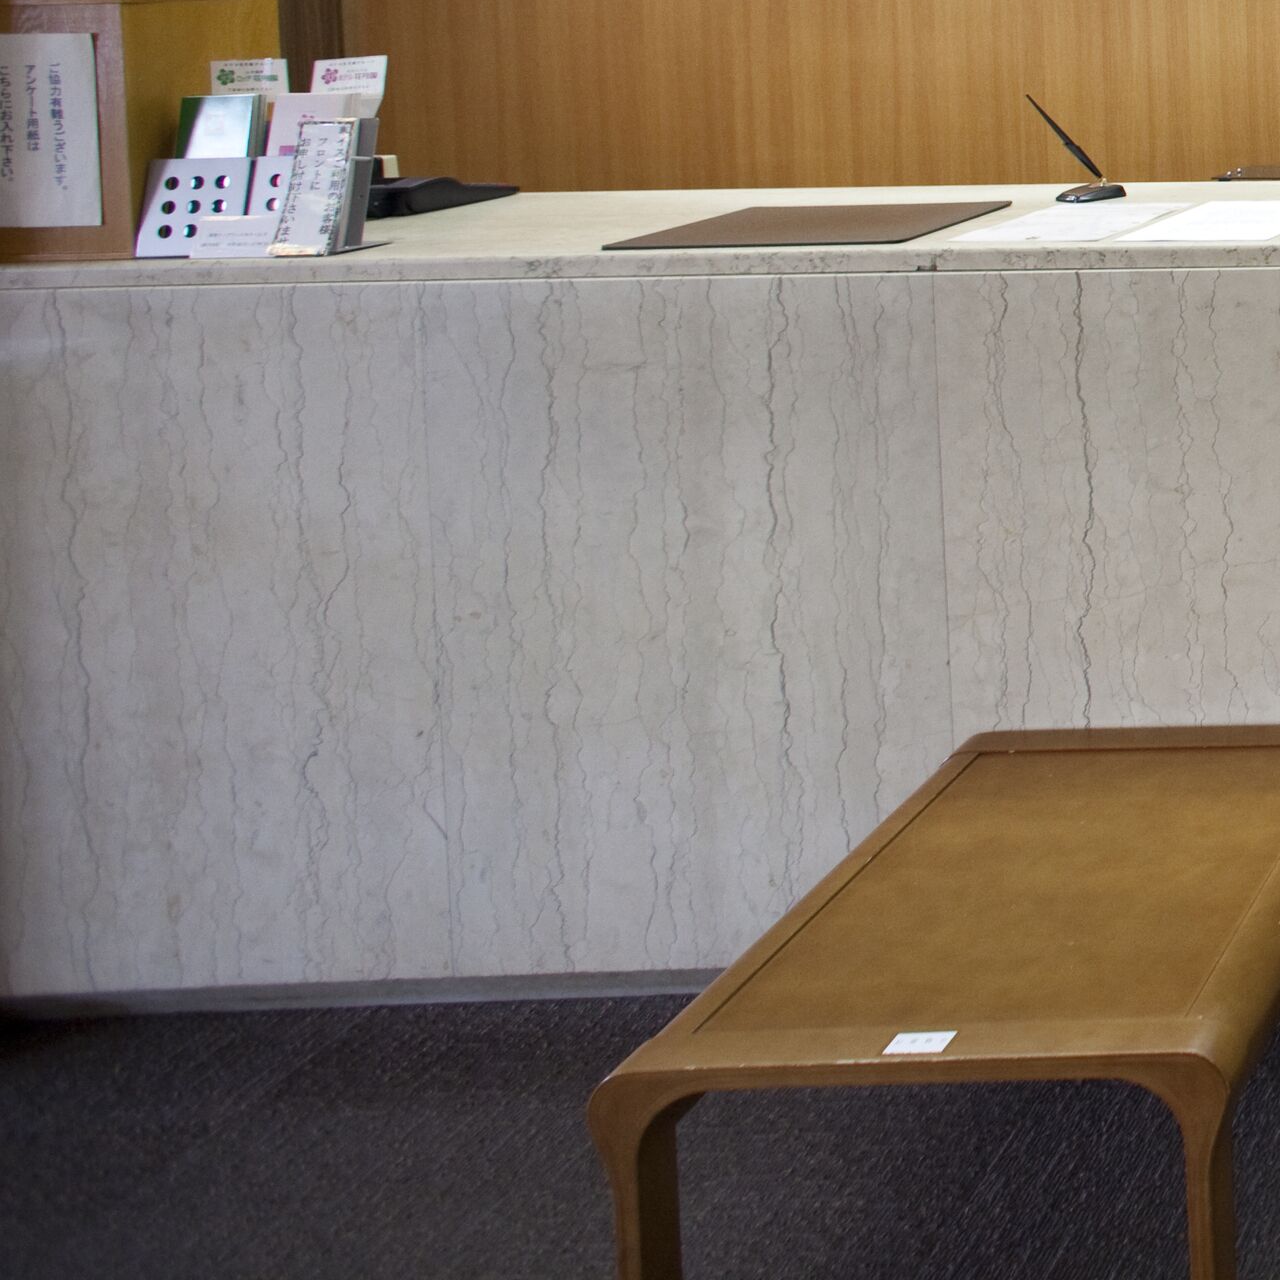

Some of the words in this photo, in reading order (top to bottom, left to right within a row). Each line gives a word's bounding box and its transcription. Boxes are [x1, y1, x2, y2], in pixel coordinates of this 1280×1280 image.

[25, 64, 40, 151] アンケート用紙は
[310, 137, 328, 190] フロントに
